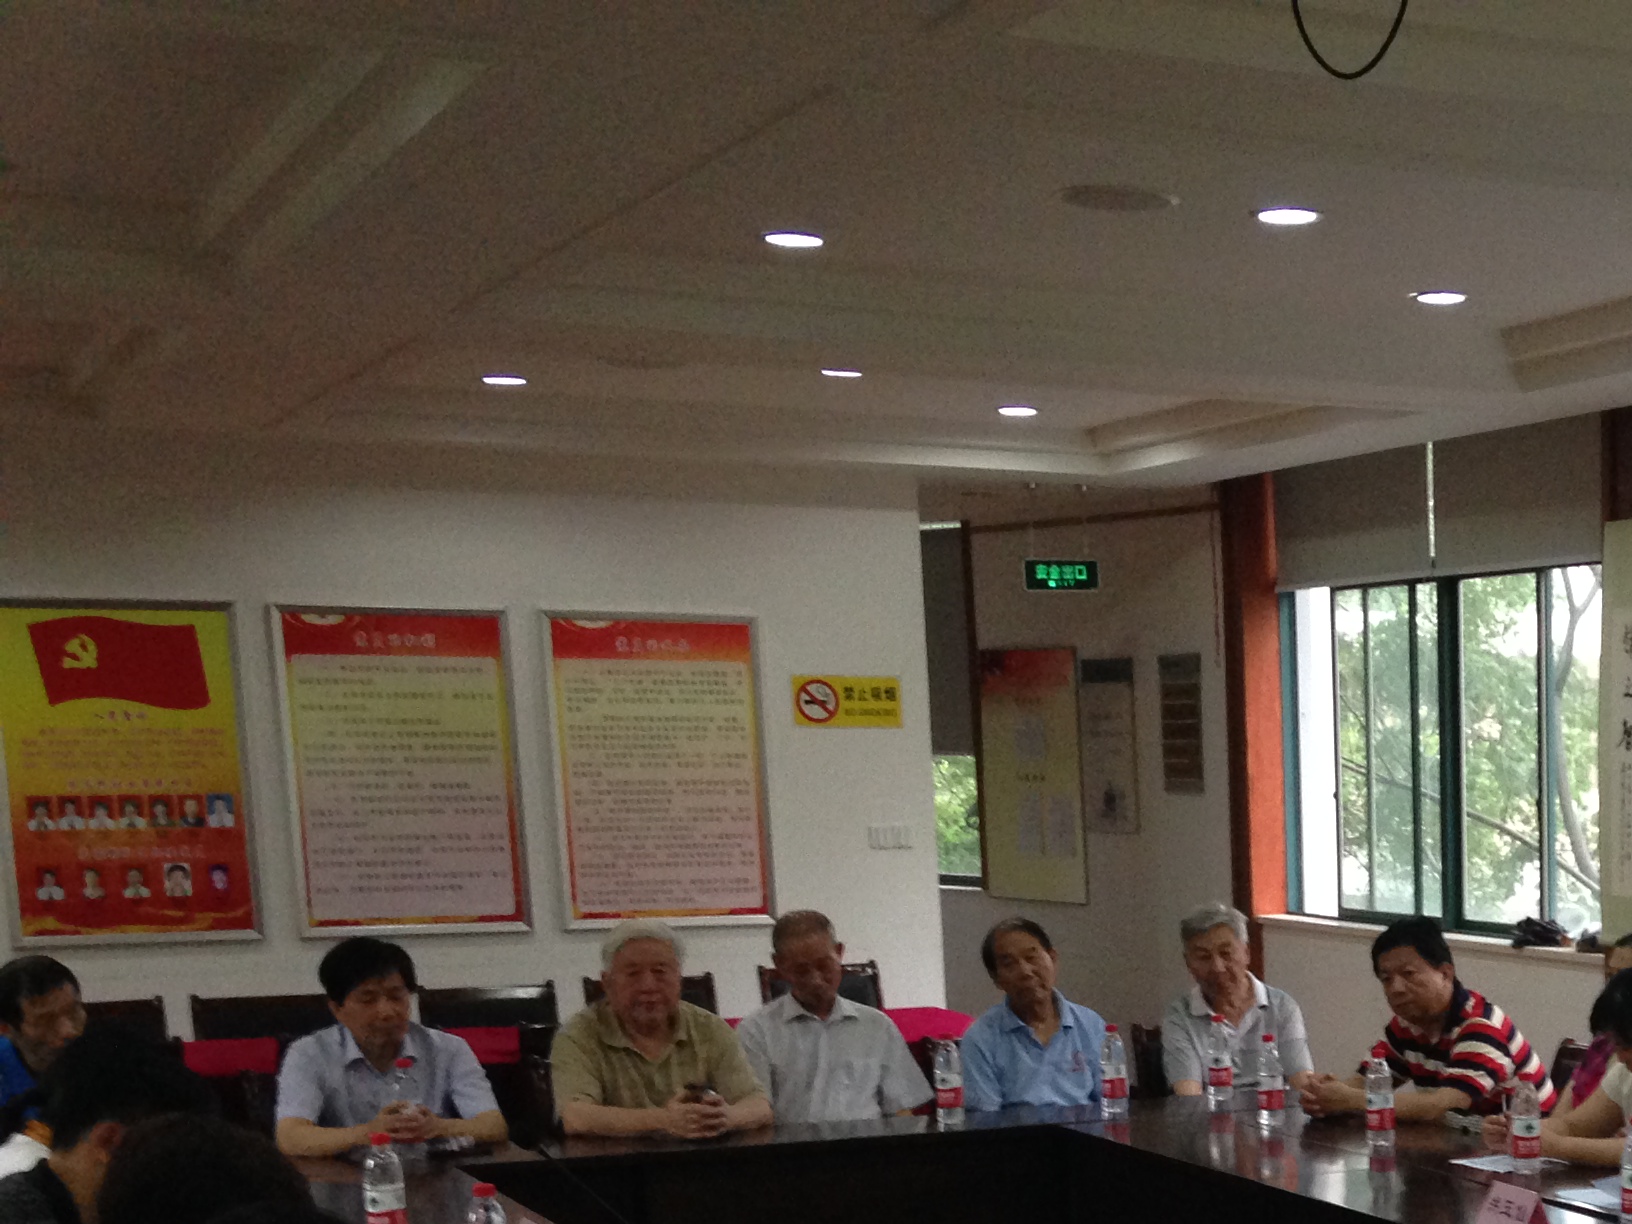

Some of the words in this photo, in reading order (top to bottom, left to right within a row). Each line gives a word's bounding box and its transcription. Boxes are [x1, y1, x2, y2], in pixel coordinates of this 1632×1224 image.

[1035, 564, 1087, 580] 安全出口
[843, 686, 897, 702] 禁止吸烟
